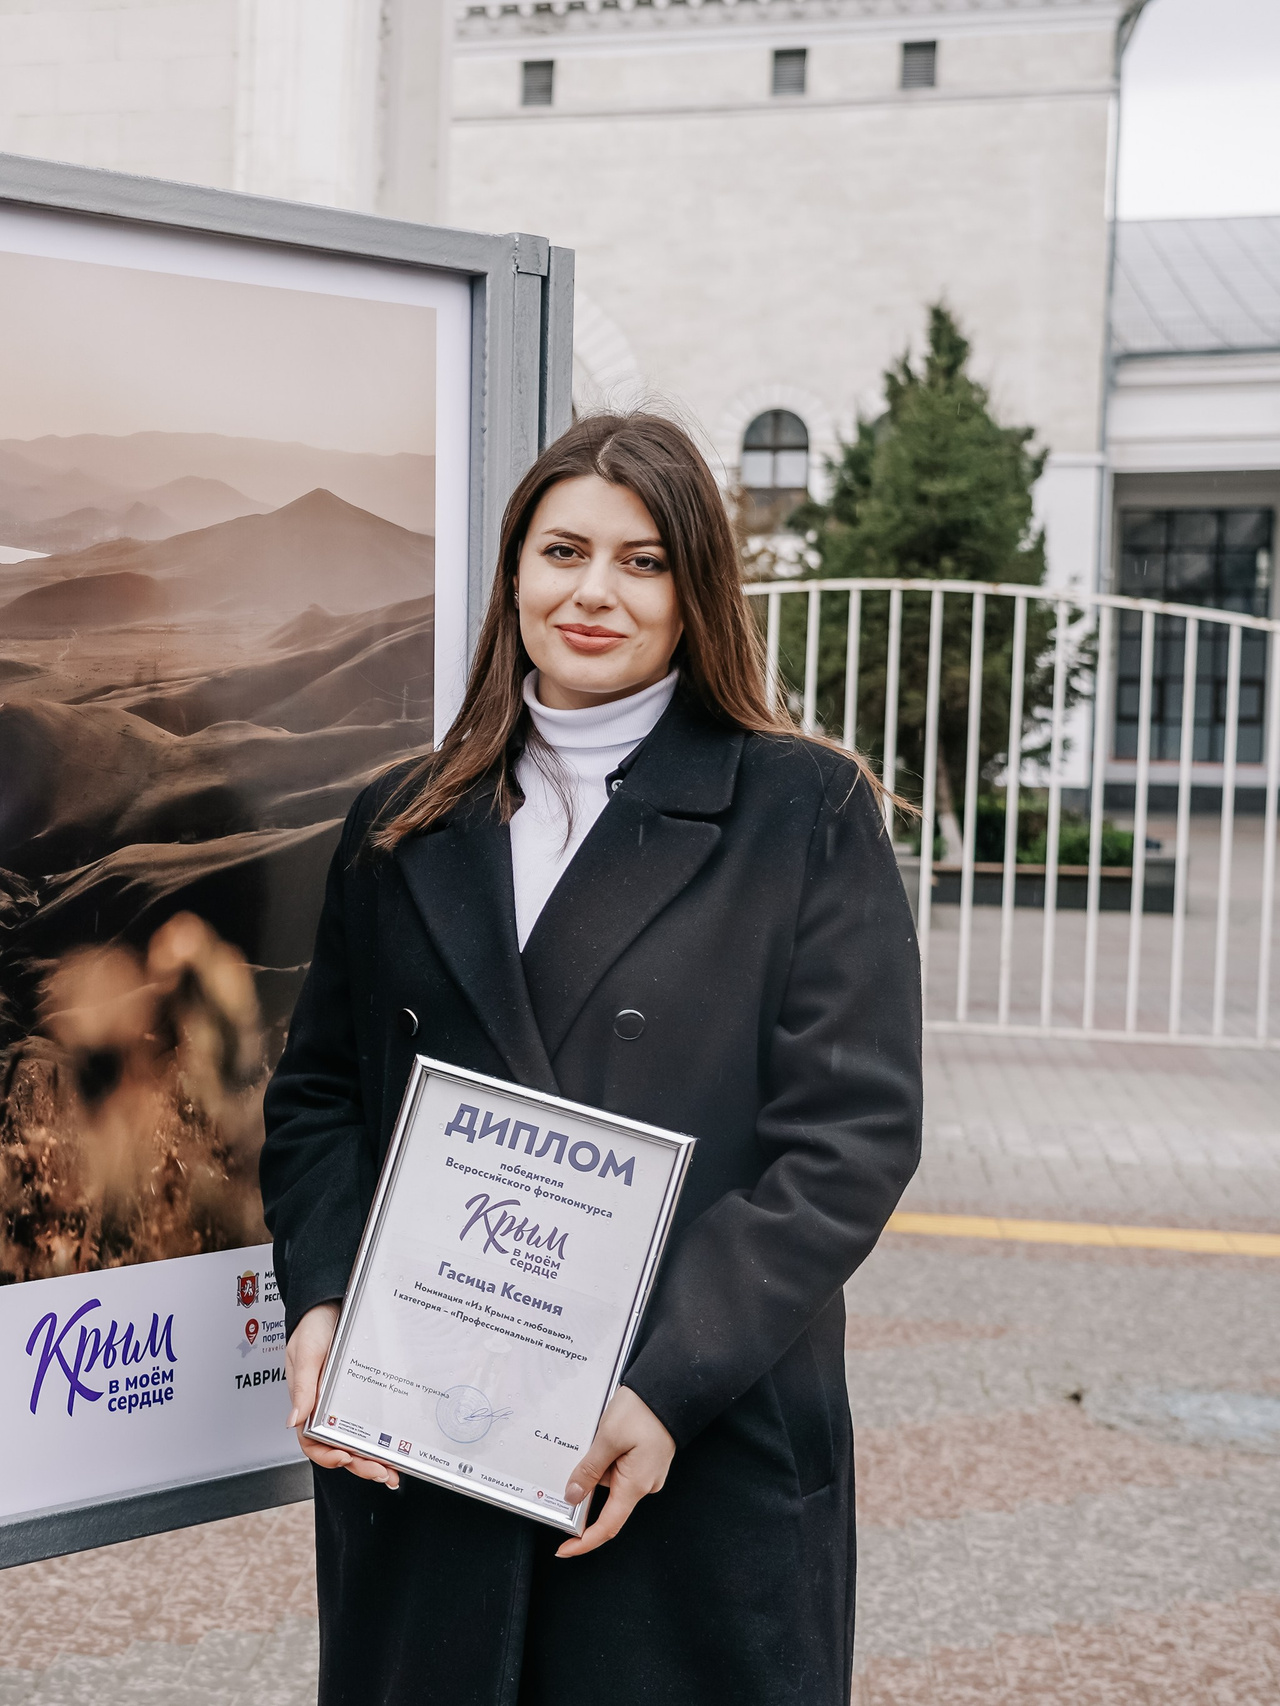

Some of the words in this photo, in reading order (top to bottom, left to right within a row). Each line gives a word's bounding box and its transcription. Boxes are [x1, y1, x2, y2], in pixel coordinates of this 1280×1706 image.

[443, 1102, 636, 1187] ДИПЛОМ
[445, 1156, 532, 1192] Всероссийского
[533, 1185, 613, 1219] фотоконкурса
[499, 1163, 564, 1189] победителя
[459, 1193, 569, 1260] Крым
[510, 1257, 558, 1280] сердце
[513, 1248, 521, 1257] в
[524, 1252, 561, 1270] моём
[437, 1260, 496, 1294] Гасица
[500, 1281, 563, 1317] Ксения
[398, 1293, 442, 1313] категория
[450, 1310, 544, 1347] «Профессиональный
[544, 1343, 588, 1362] конкурс»
[414, 1280, 464, 1305] Номинация
[484, 1304, 515, 1322] Крыма
[522, 1320, 574, 1344] любовью»,
[25, 1298, 178, 1417] Крым
[262, 1332, 287, 1343] порта
[107, 1386, 174, 1414] сердце
[108, 1379, 119, 1395] в
[125, 1366, 174, 1392] моём
[346, 1368, 388, 1389] Республики
[388, 1383, 409, 1396] Крым
